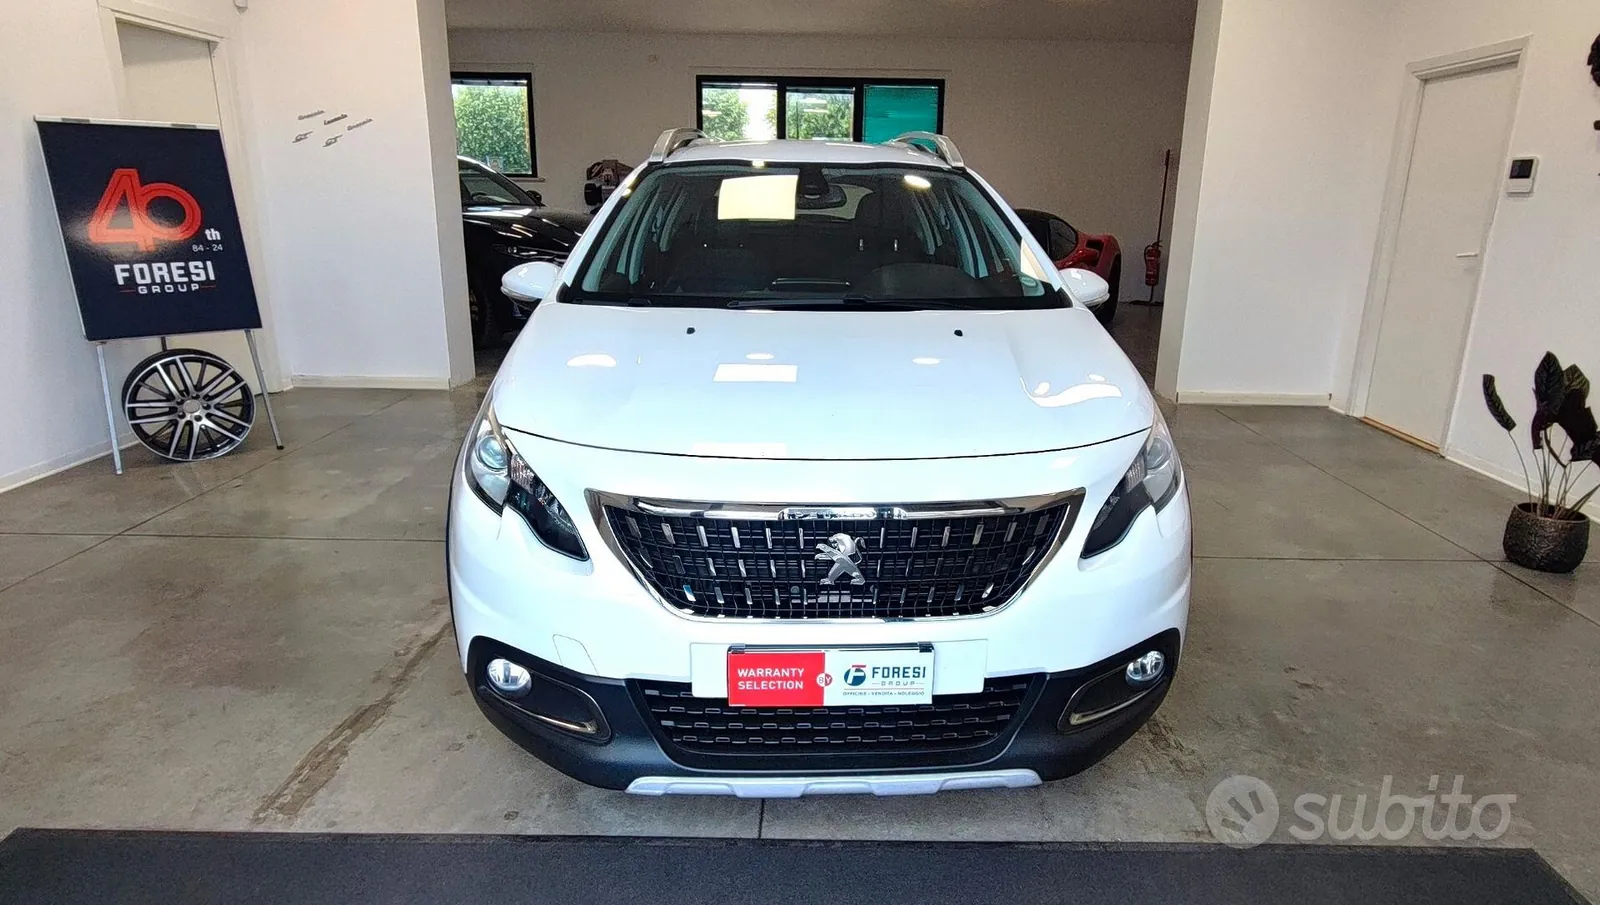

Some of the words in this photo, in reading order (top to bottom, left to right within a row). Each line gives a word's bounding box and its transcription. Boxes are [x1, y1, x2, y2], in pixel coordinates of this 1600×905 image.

[87, 168, 202, 253] 40
[205, 228, 221, 241] th
[192, 244, 204, 252] 84
[212, 243, 223, 252] 24
[114, 260, 216, 286] FORESI
[138, 283, 200, 294] GROUP
[737, 667, 805, 678] WARRANTY
[871, 666, 926, 679] FORESI
[737, 681, 804, 690] SELECTION
